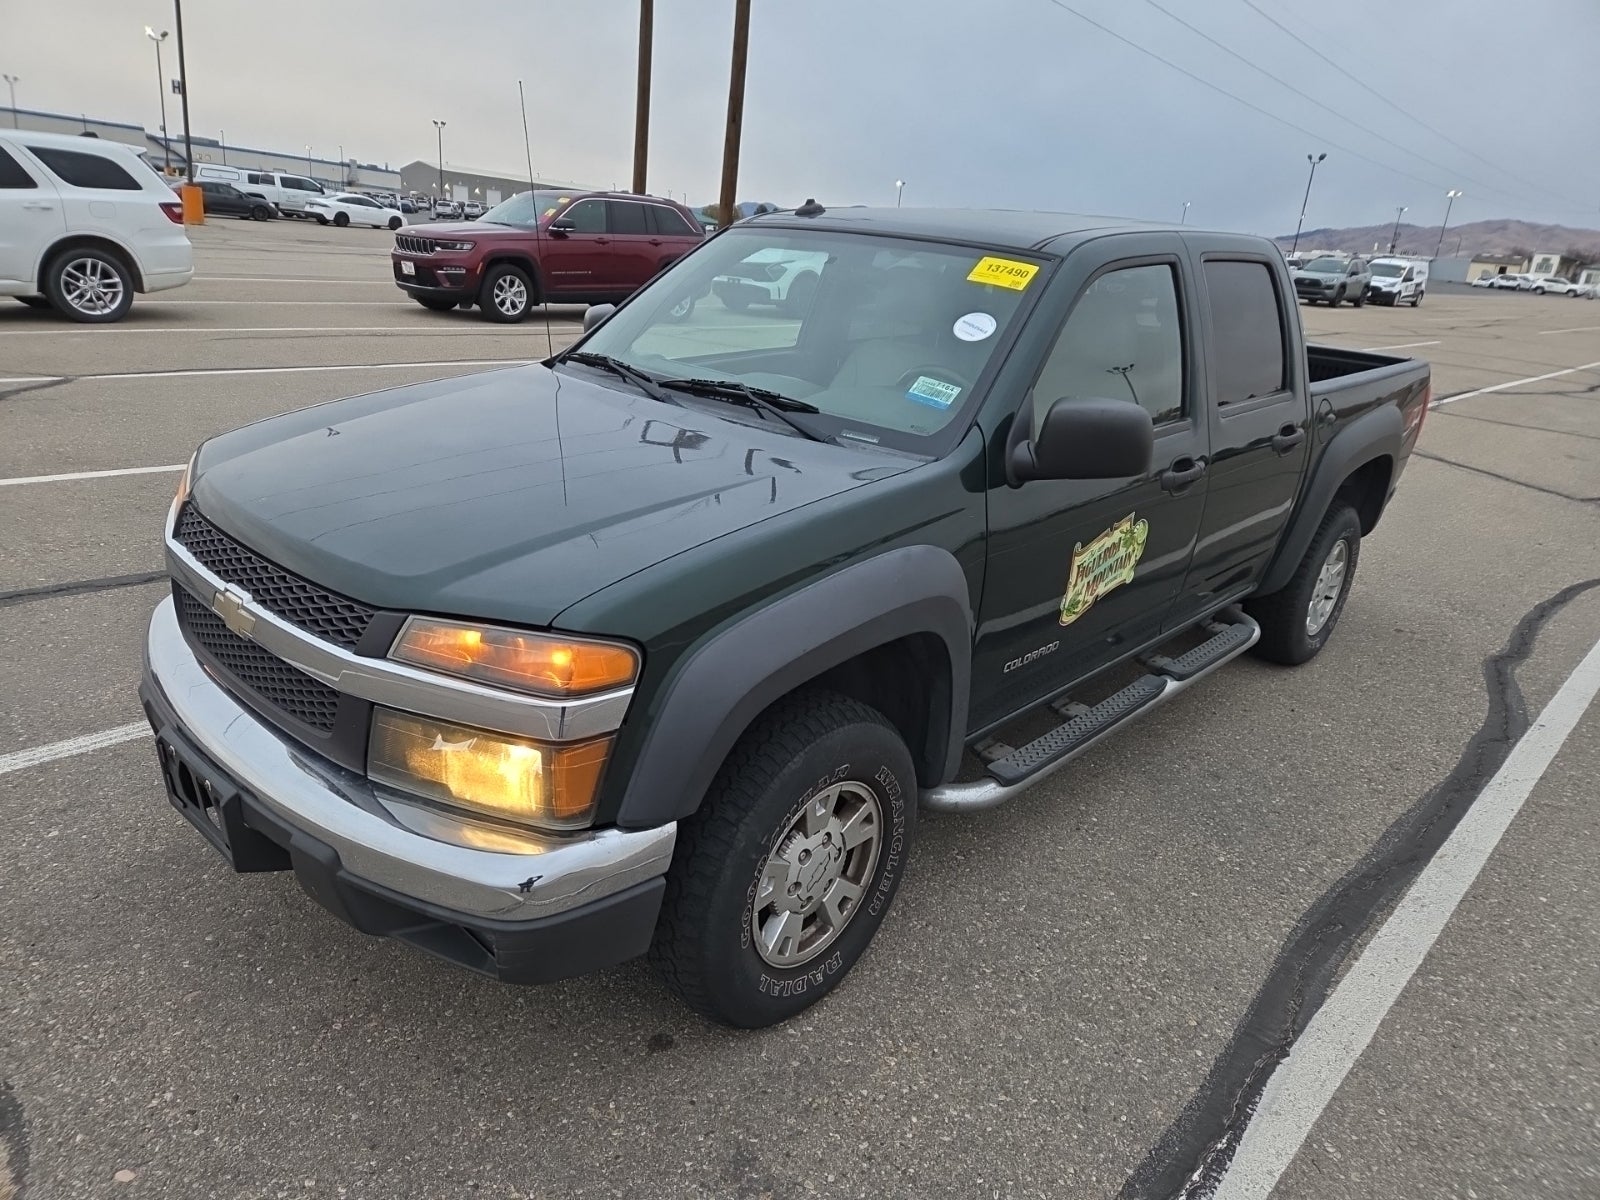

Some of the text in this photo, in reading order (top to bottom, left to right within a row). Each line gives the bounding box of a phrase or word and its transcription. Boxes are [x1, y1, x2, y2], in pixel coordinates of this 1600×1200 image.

[986, 263, 1030, 279] 137490
[1084, 551, 1132, 598] MOUNTAIN
[1003, 640, 1060, 673] COLORADO
[868, 765, 905, 916] WRANGLER
[759, 951, 843, 997] RADIAL
